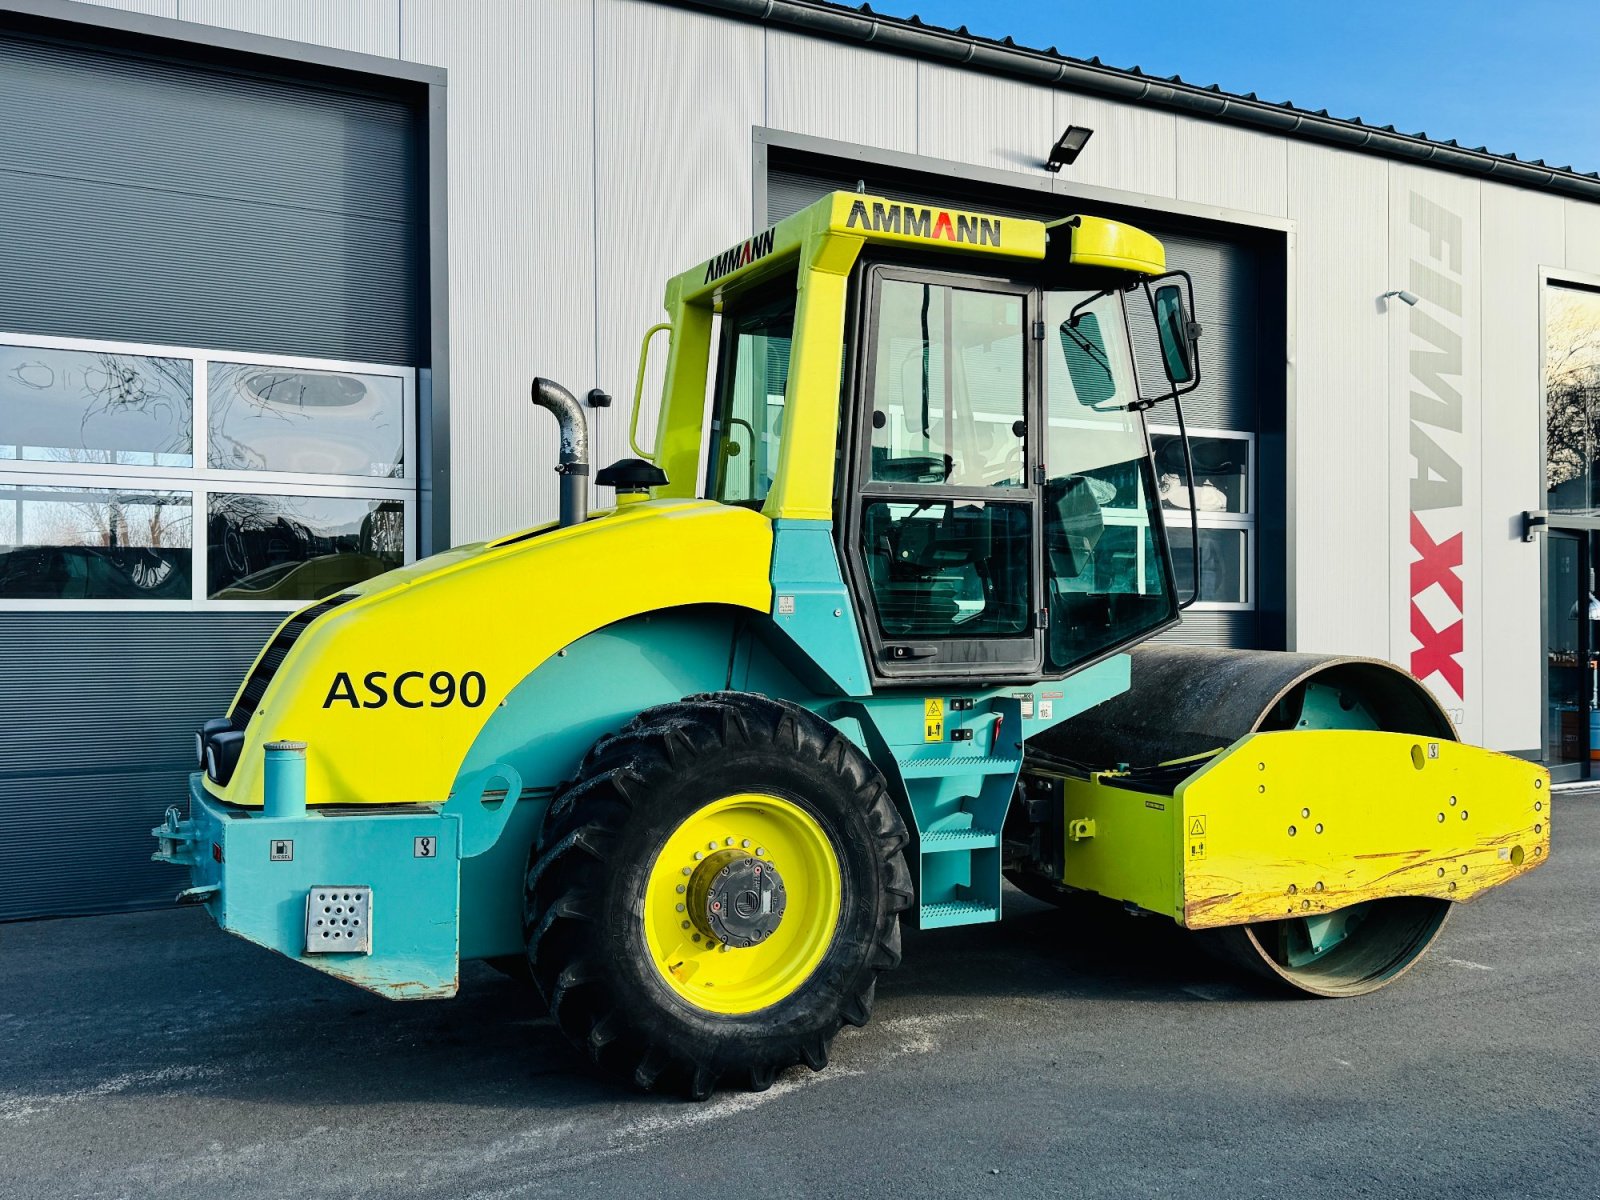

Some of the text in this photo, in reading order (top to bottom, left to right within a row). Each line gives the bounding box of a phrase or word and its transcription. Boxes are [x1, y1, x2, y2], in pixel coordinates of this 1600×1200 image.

[846, 200, 1000, 247] AMMANN
[704, 226, 775, 285] AMMANN
[1410, 190, 1463, 702] FIMAXX
[322, 671, 487, 709] ASC90
